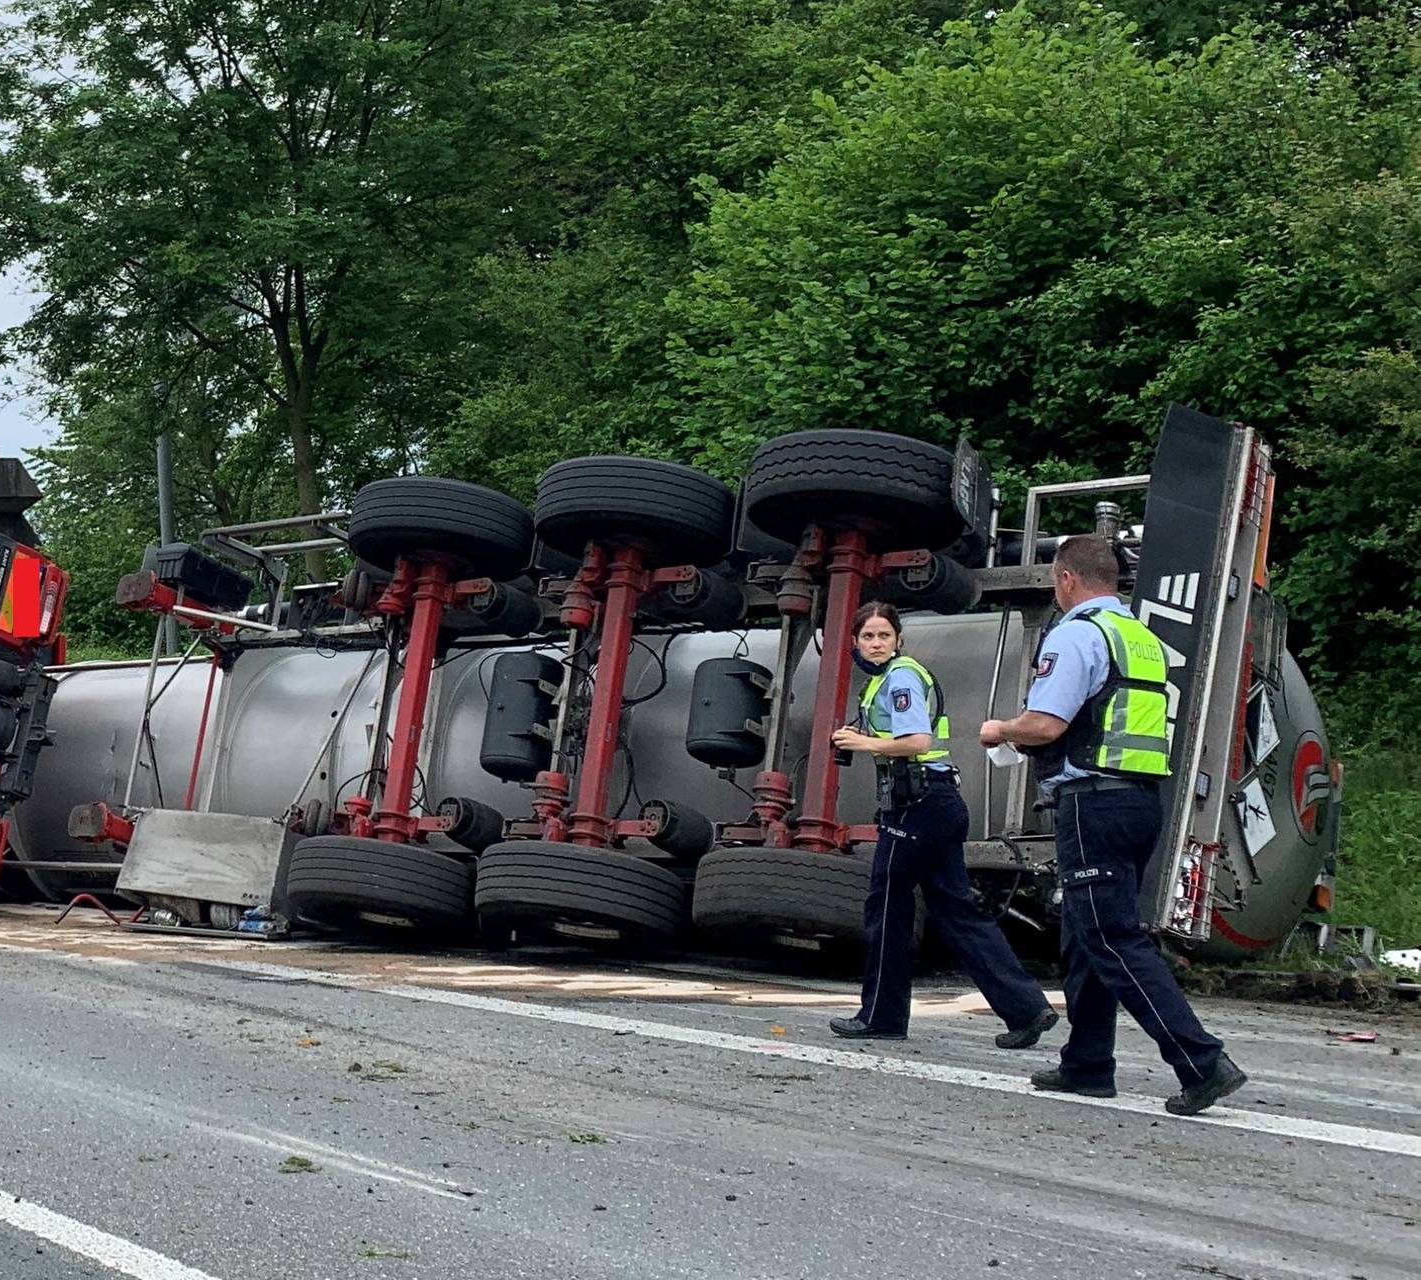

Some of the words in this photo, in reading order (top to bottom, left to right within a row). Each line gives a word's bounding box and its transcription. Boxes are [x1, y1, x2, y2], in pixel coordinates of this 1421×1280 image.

[1128, 640, 1162, 663] POLIZEI
[887, 826, 907, 838] POLIZEI
[1074, 868, 1099, 879] POLIZEI
